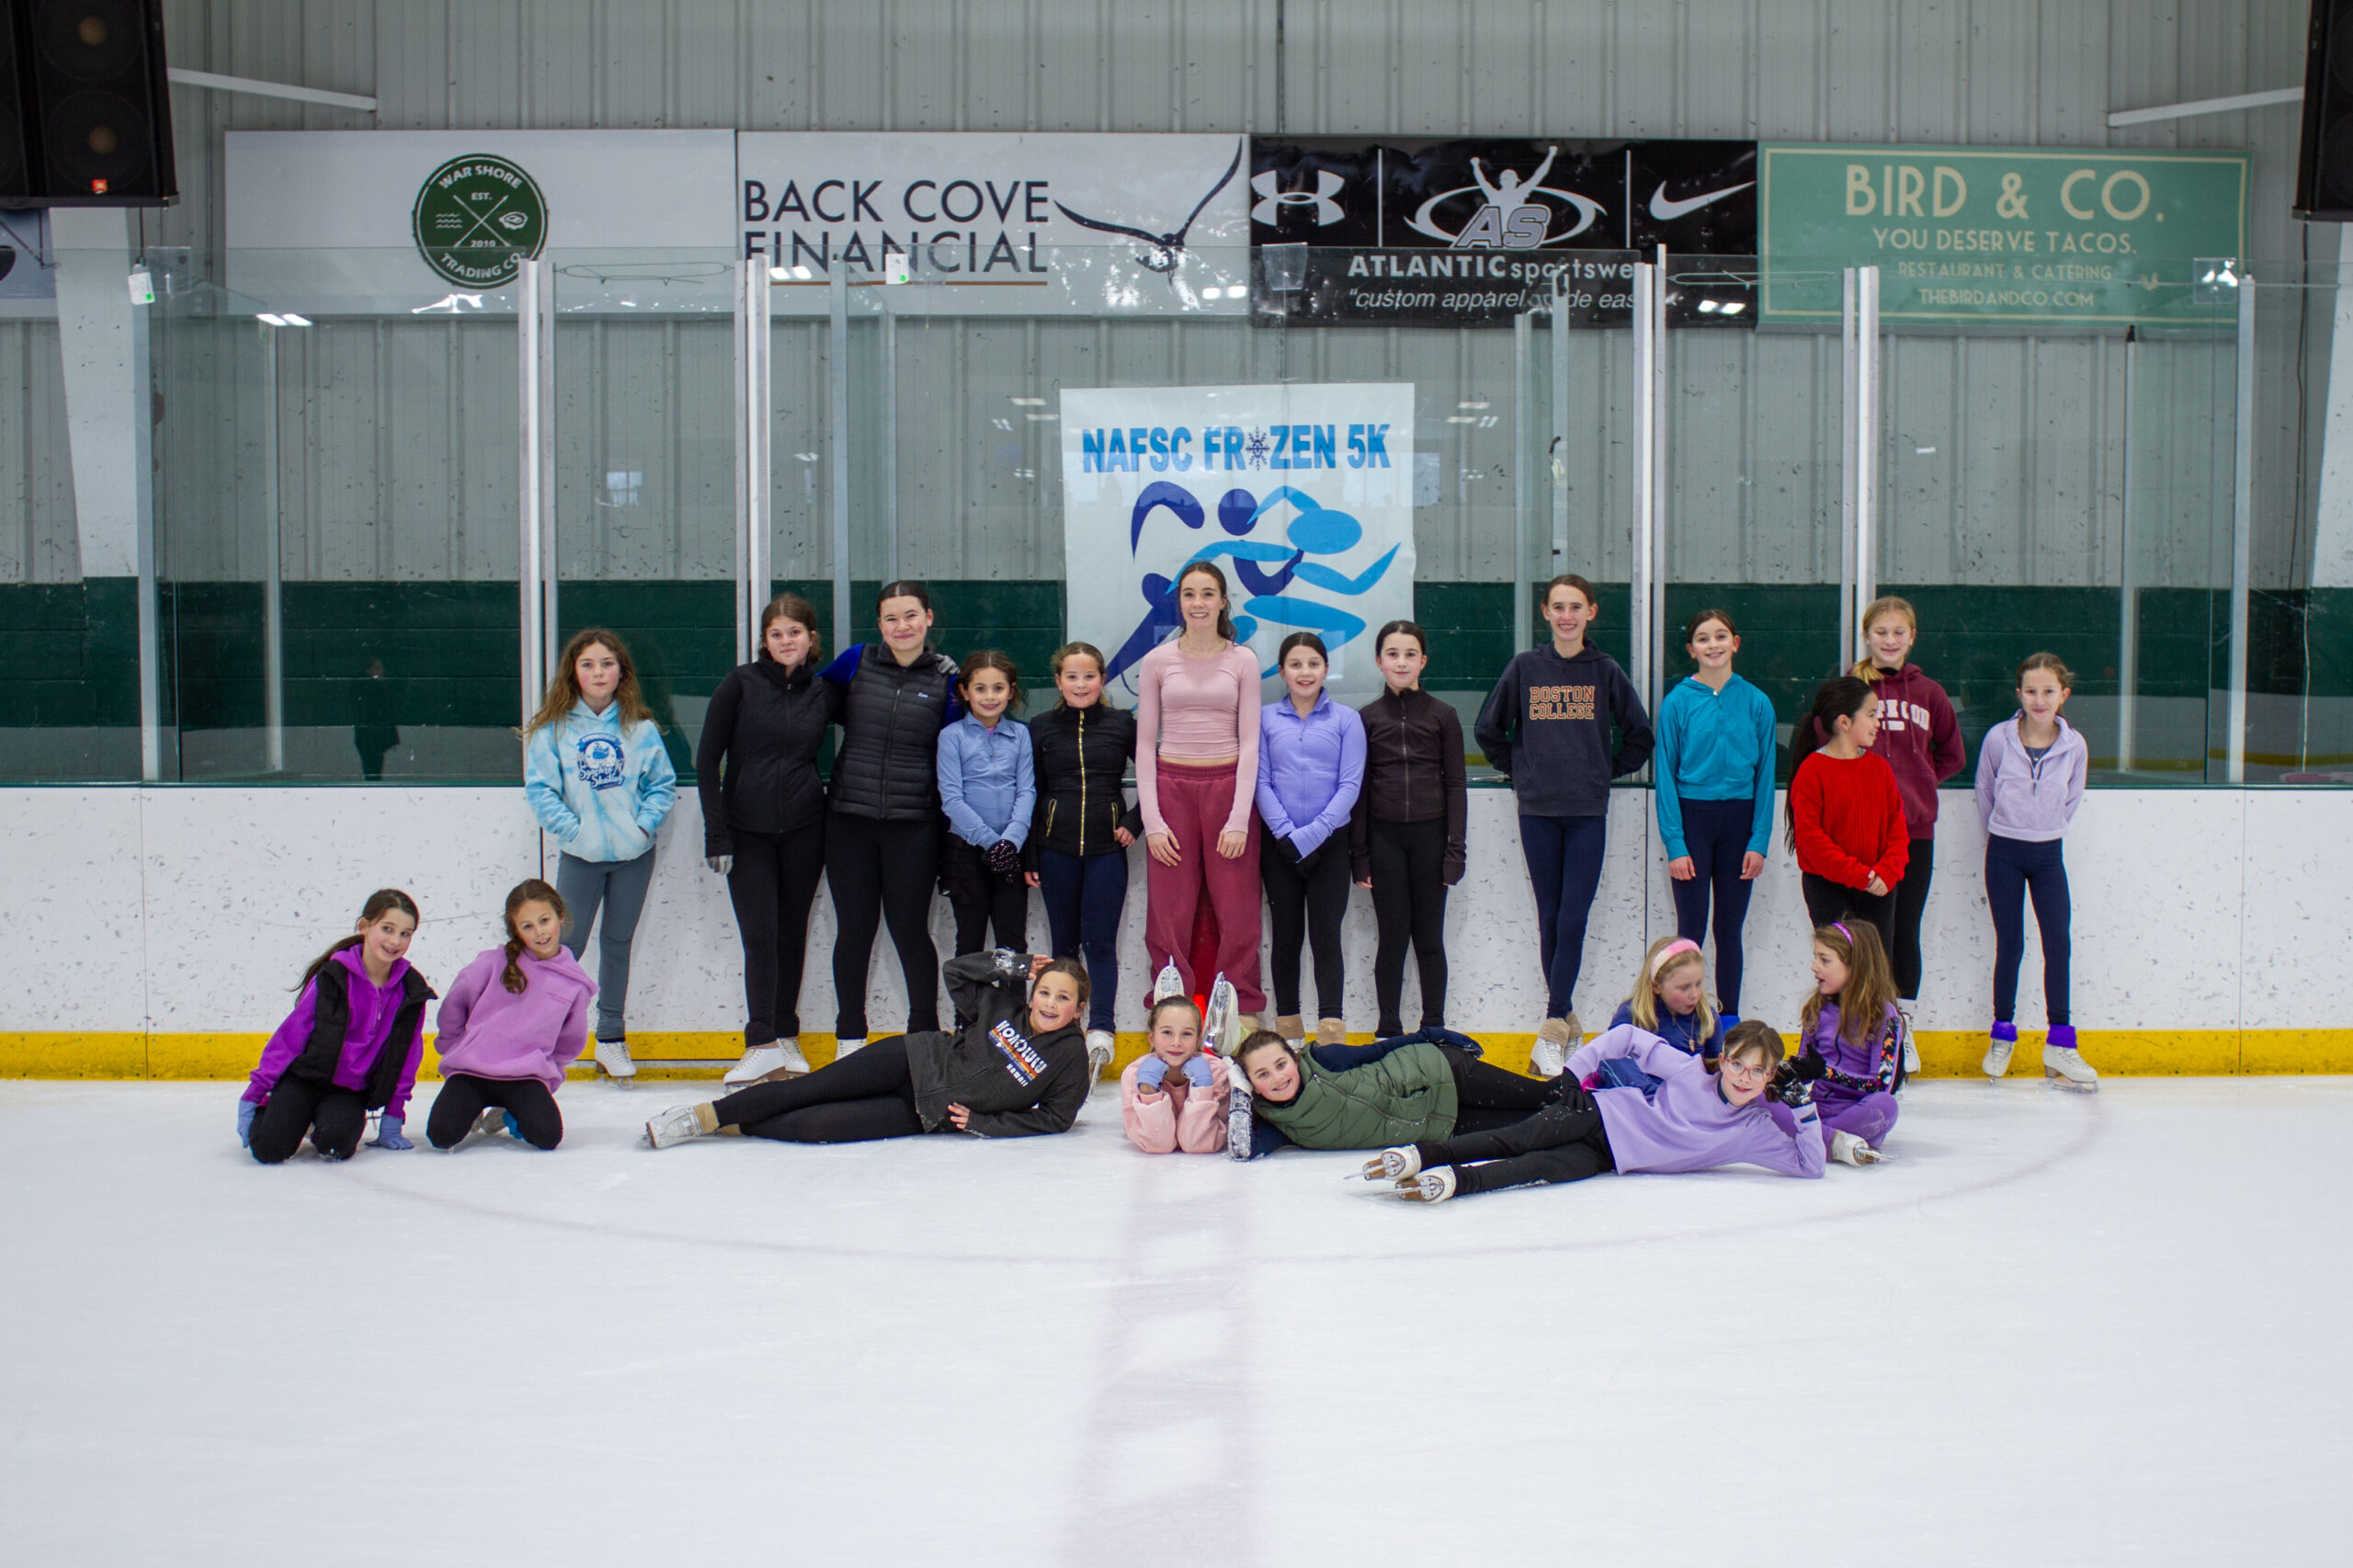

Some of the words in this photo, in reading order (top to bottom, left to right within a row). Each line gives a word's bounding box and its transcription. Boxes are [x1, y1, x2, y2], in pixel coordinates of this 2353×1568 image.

[438, 166, 472, 189] WAR
[474, 165, 523, 189] SHORE
[471, 192, 493, 200] EST.
[745, 179, 883, 222] BACK
[904, 179, 1049, 223] COVE
[1846, 165, 1967, 217] BIRD
[1996, 172, 2029, 219] &
[2060, 169, 2165, 222] CO.
[1451, 204, 1552, 249] AS
[745, 230, 1048, 274] FINANCIAL
[1874, 228, 1927, 249] YOU
[1937, 229, 2035, 252] DESERVE
[2046, 232, 2137, 254] TACOS.
[441, 253, 502, 278] TRADING
[1899, 261, 2005, 278] RESTAURANT
[2013, 265, 2023, 278] &
[2032, 264, 2112, 280] CATERING
[1442, 289, 1526, 312] apparel
[1598, 292, 1633, 308] eas
[1919, 289, 2094, 306] THEBIRDANDCO.COM
[1082, 426, 1192, 473] NAFSC
[1347, 424, 1392, 469] 5K
[1529, 686, 1595, 703] BOSTON
[1529, 702, 1595, 720] COLLEGE
[995, 1019, 1048, 1074] HONOLULU
[1006, 1063, 1029, 1086] HAWAII
